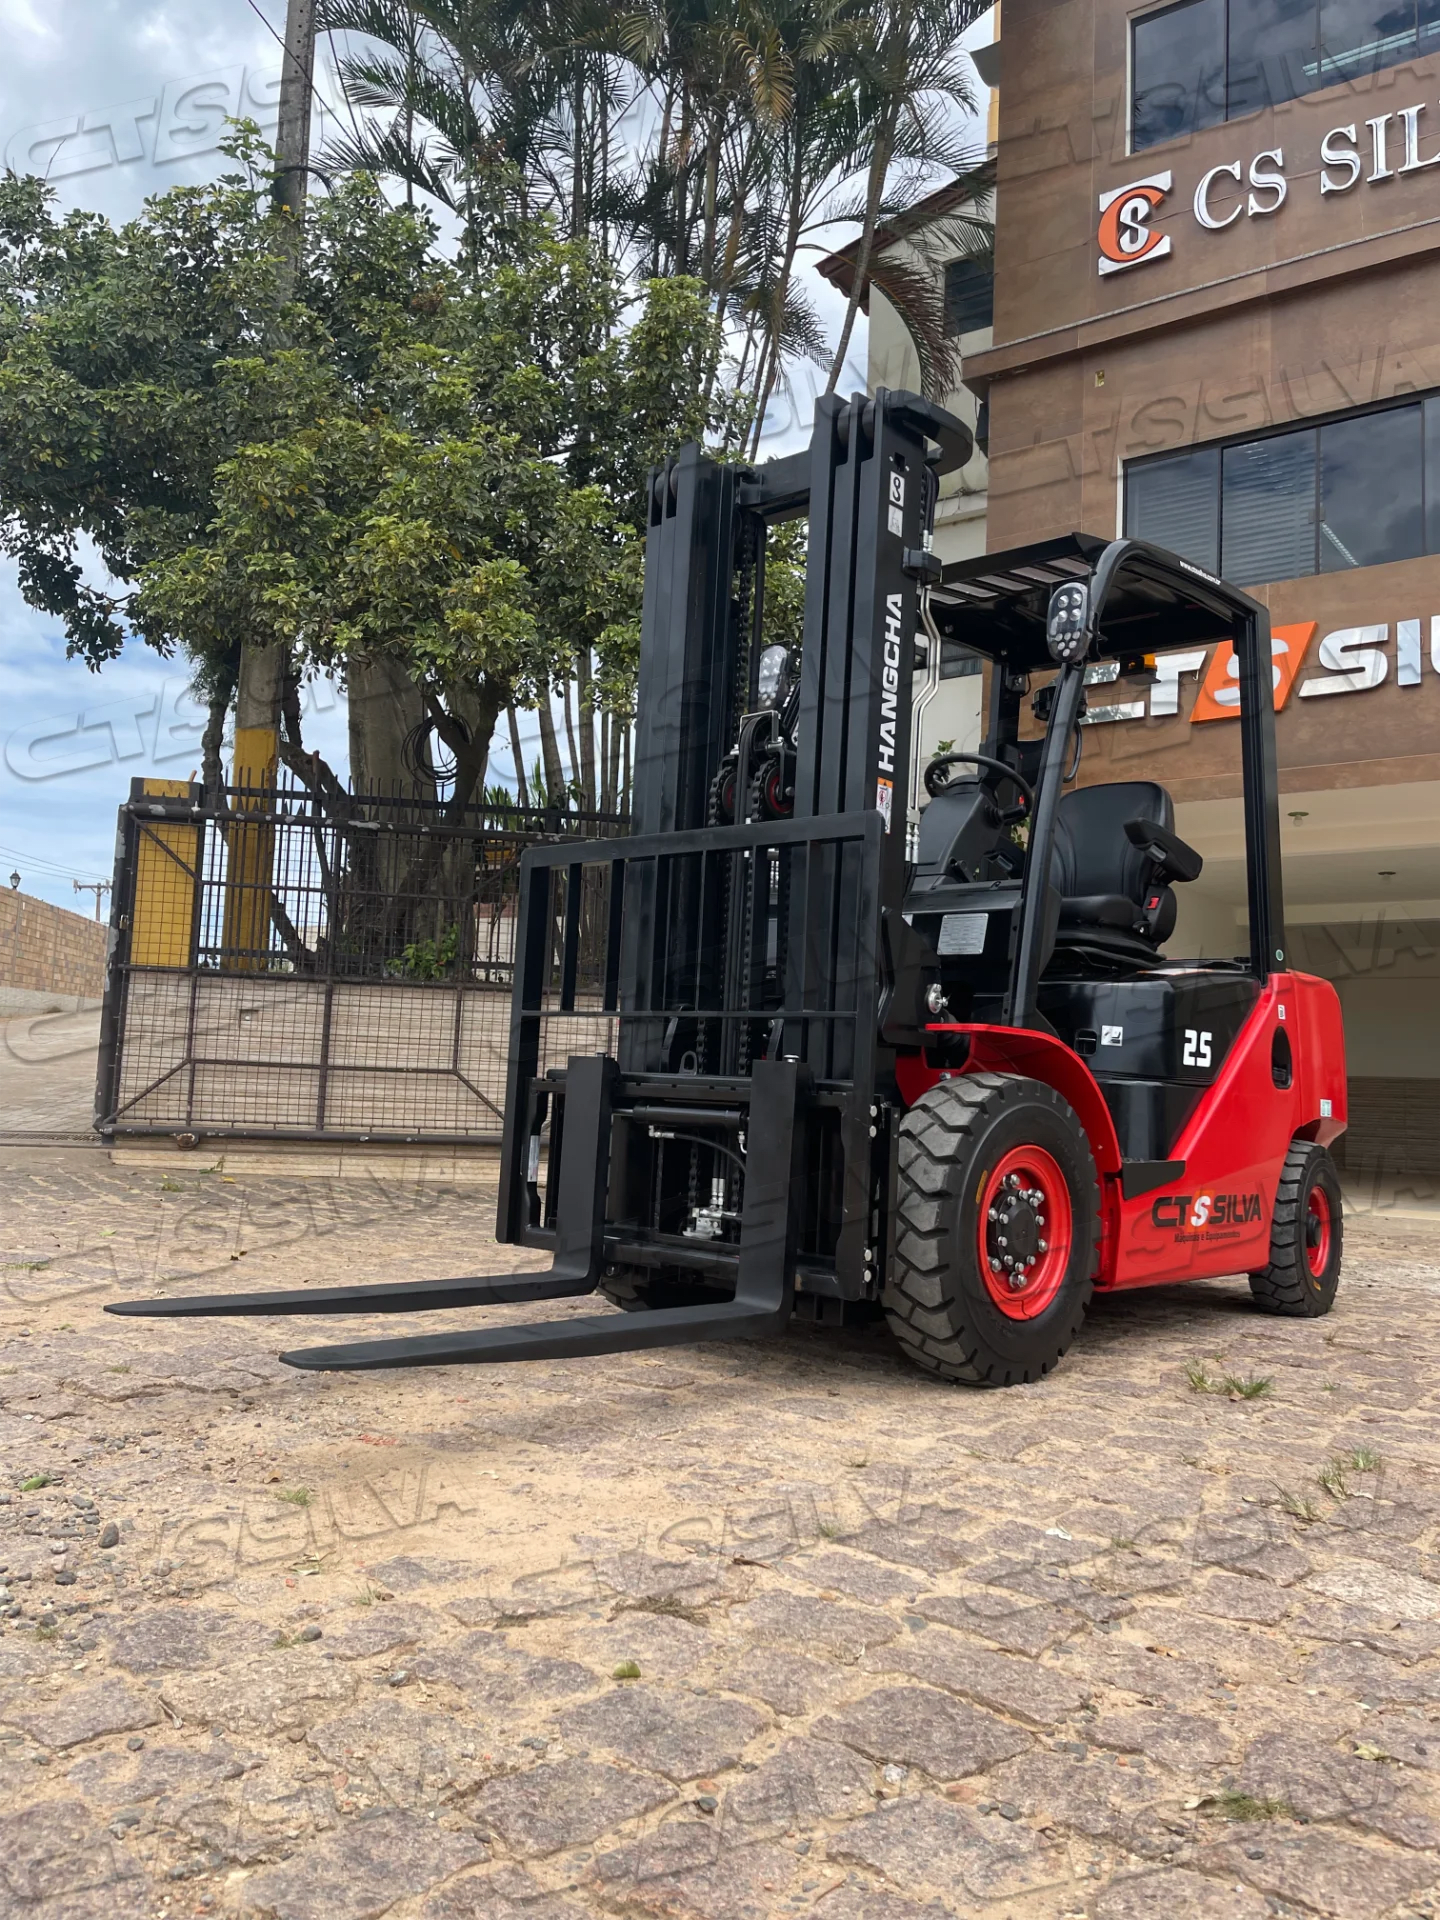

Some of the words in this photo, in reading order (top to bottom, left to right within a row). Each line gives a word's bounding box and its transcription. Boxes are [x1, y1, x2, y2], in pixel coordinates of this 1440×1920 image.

[1193, 148, 1287, 229] CS
[878, 593, 903, 773] HANGCHA
[1183, 1029, 1212, 1067] 25
